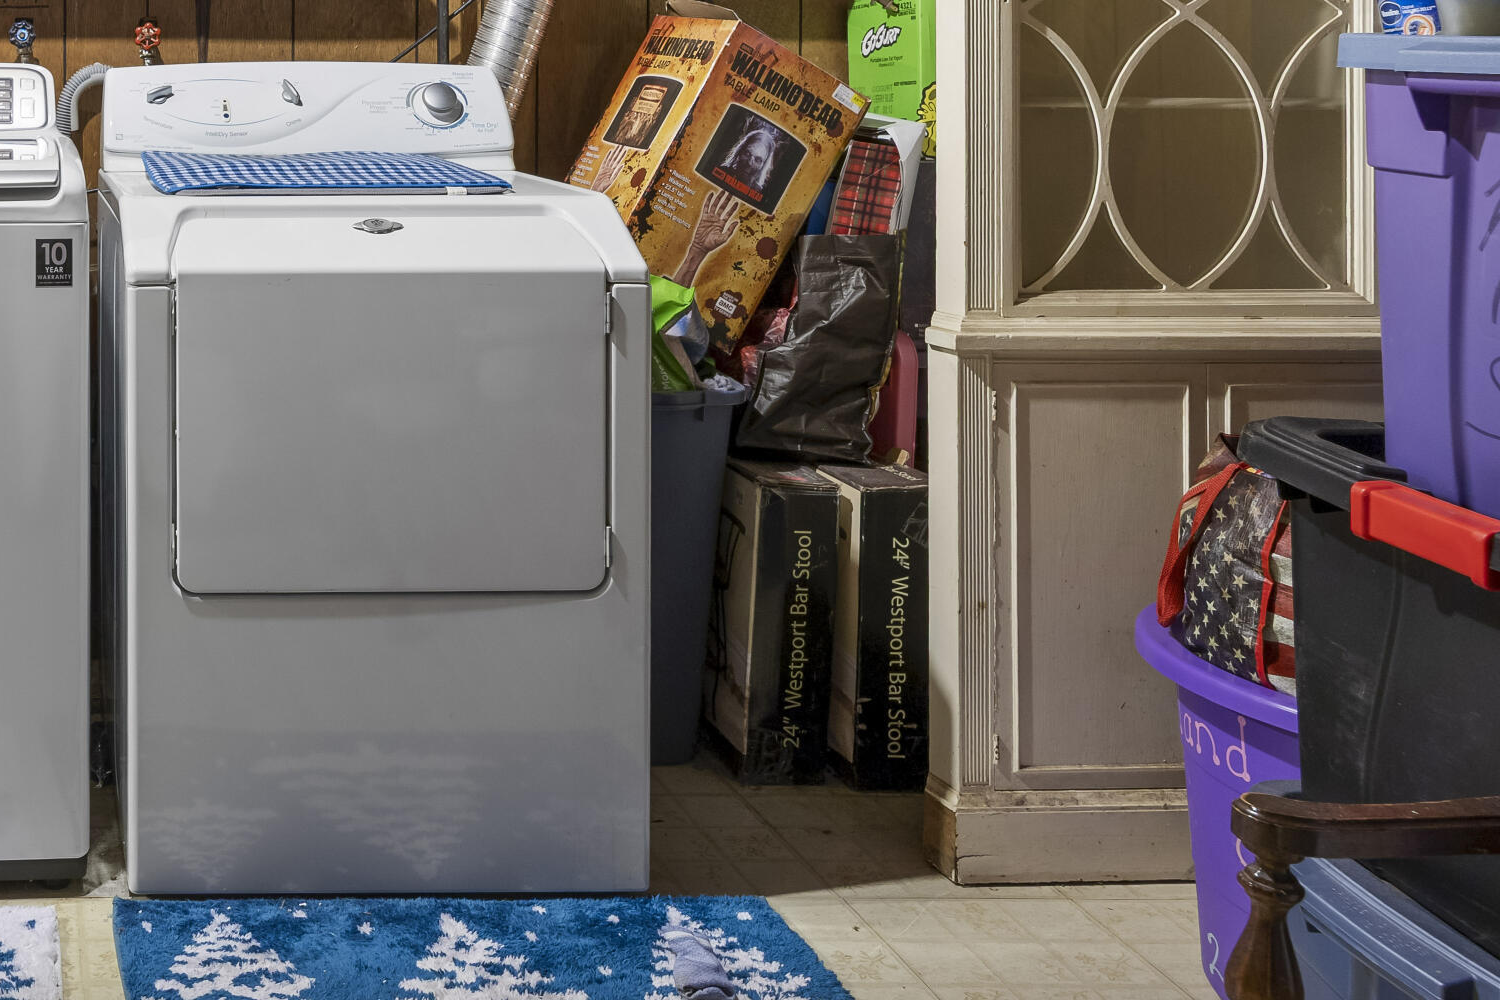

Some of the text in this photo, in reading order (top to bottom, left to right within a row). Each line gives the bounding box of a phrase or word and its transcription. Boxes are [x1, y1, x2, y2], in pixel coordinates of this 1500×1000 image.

[653, 59, 671, 69] LAMP
[723, 72, 781, 113] TABLE LAMP
[730, 49, 803, 107] WALKING
[797, 88, 843, 131] DEAD
[41, 242, 68, 266] 10
[793, 530, 812, 579] Stool
[790, 585, 808, 616] Bar
[886, 576, 910, 669] Westport
[784, 620, 807, 712] Westport
[887, 673, 907, 706] Bar
[887, 709, 906, 759] Stool
[1180, 713, 1250, 783] and
